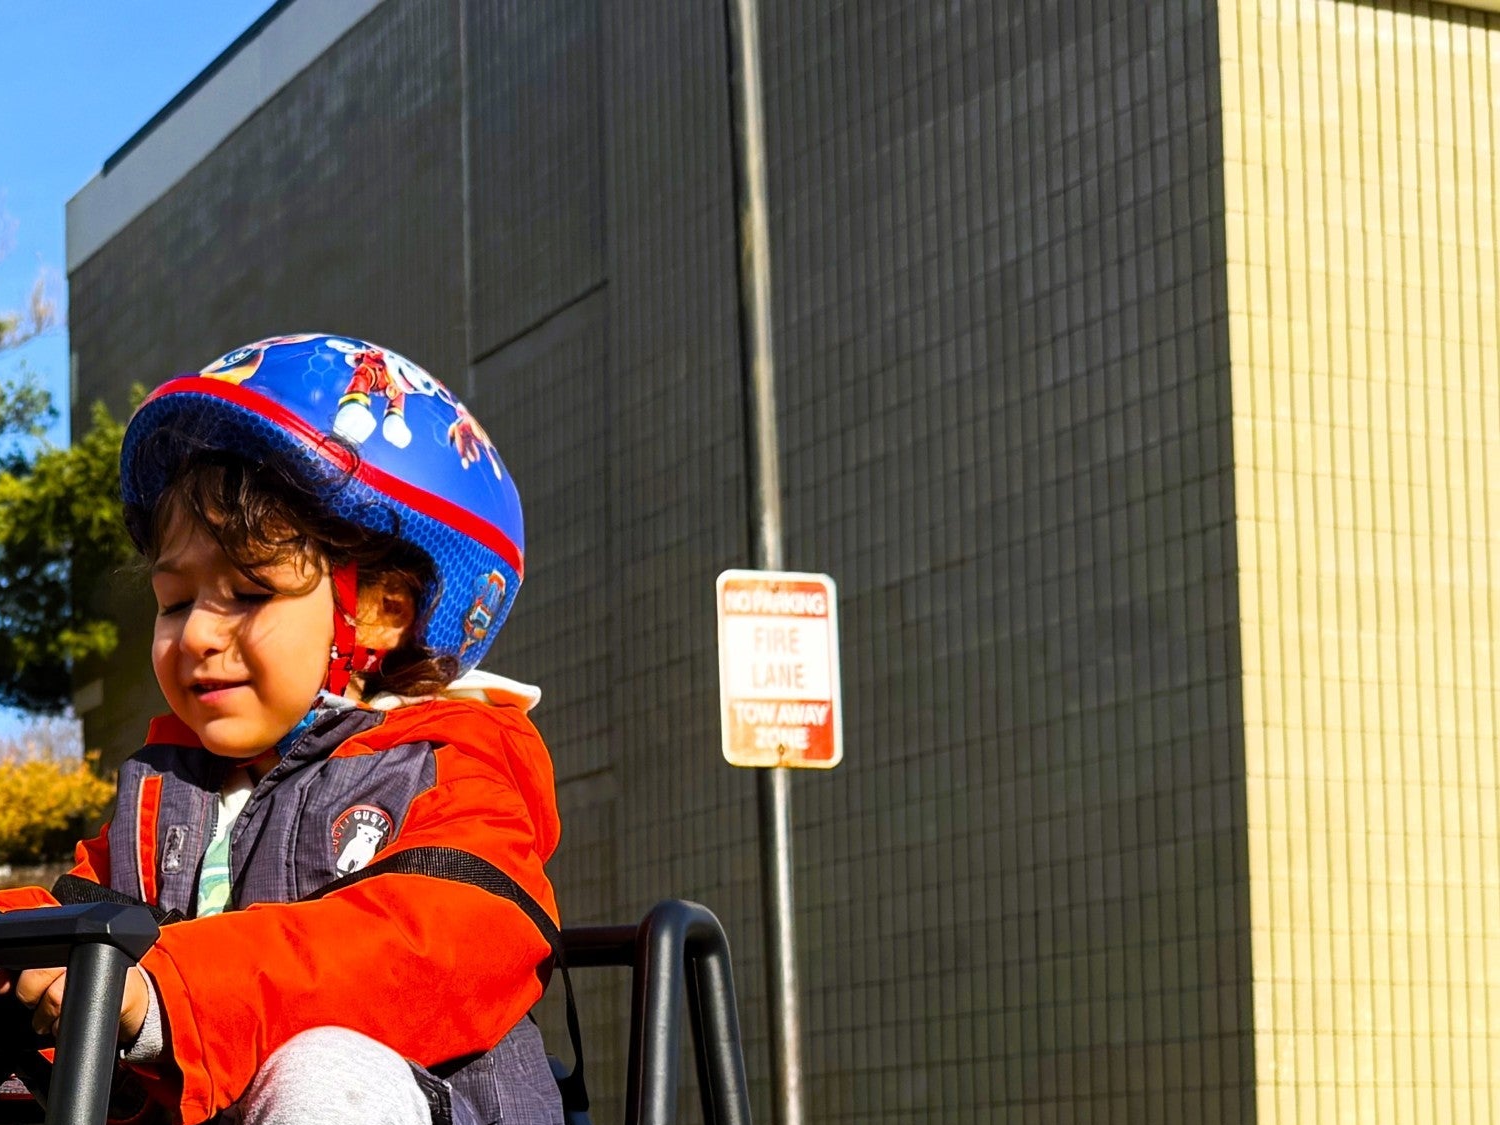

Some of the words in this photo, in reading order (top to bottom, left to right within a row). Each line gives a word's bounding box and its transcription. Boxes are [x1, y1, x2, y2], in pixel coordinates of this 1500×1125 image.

[725, 590, 750, 614] NO
[752, 591, 826, 615] PARKING
[754, 626, 800, 655] FIRE
[752, 663, 805, 689] LANE
[732, 703, 774, 724] TOW
[776, 703, 830, 726] AWAY
[755, 727, 809, 749] ZONE
